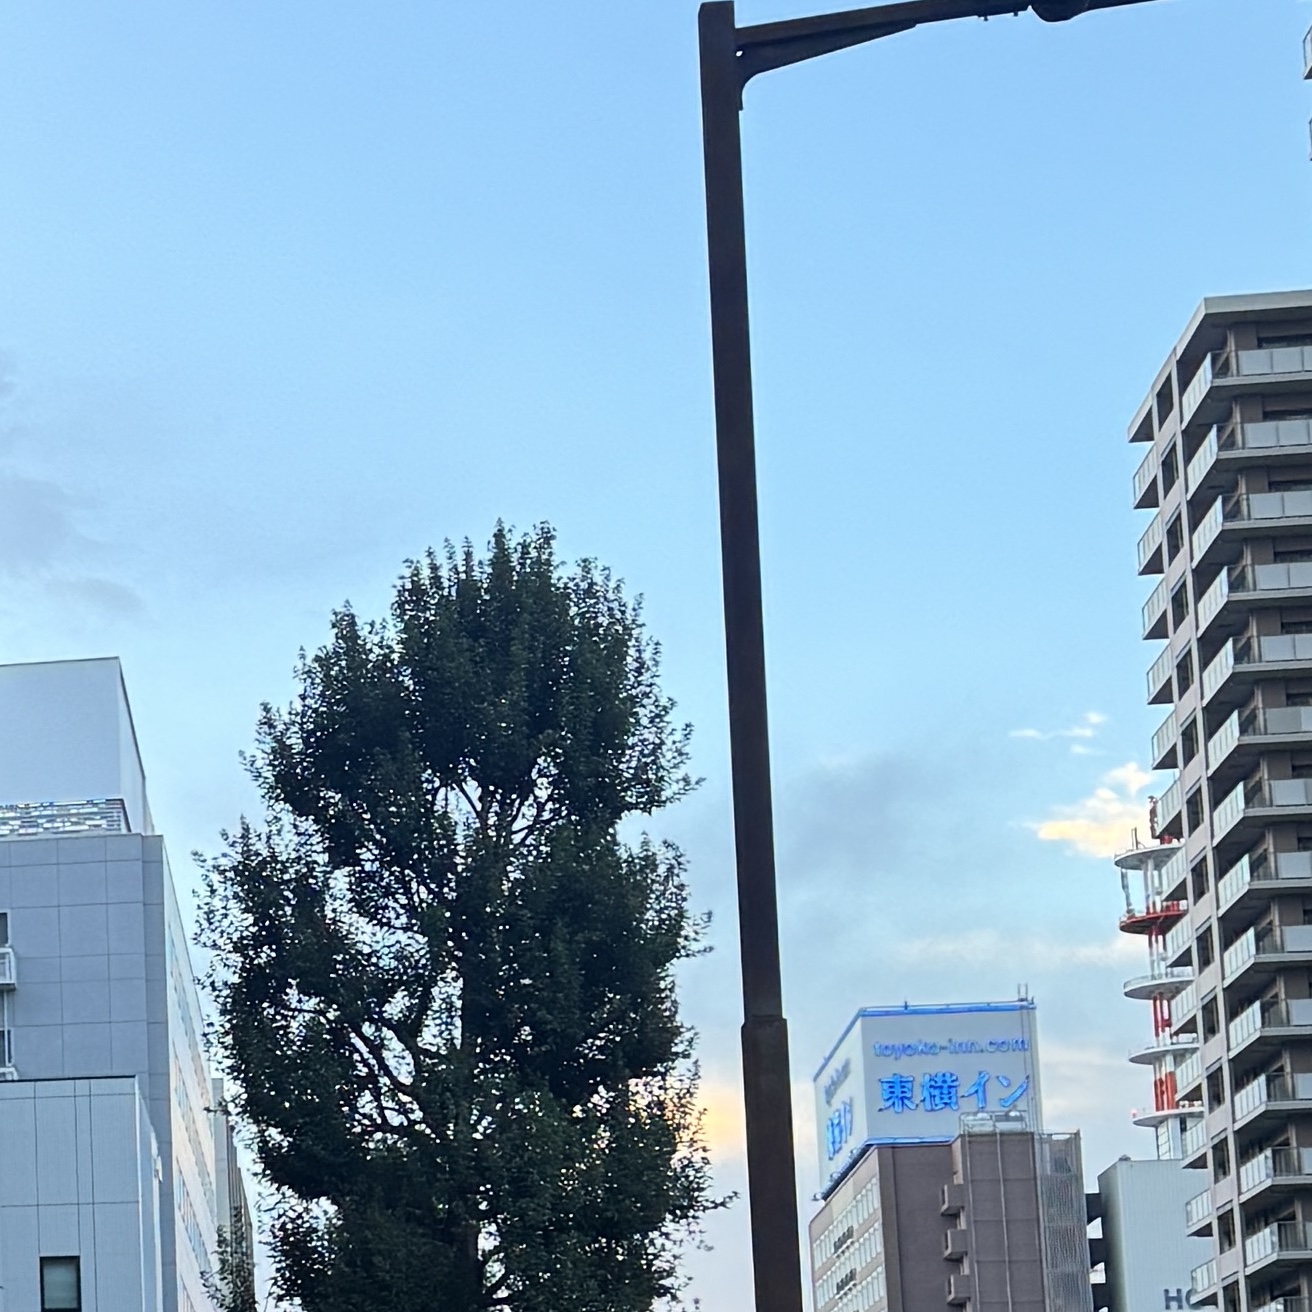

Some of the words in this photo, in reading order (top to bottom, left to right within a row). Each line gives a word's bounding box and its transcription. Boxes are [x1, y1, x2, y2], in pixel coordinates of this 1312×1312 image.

[873, 1037, 1031, 1061] toyoko-inn.com
[878, 1070, 1031, 1114] 東横イン
